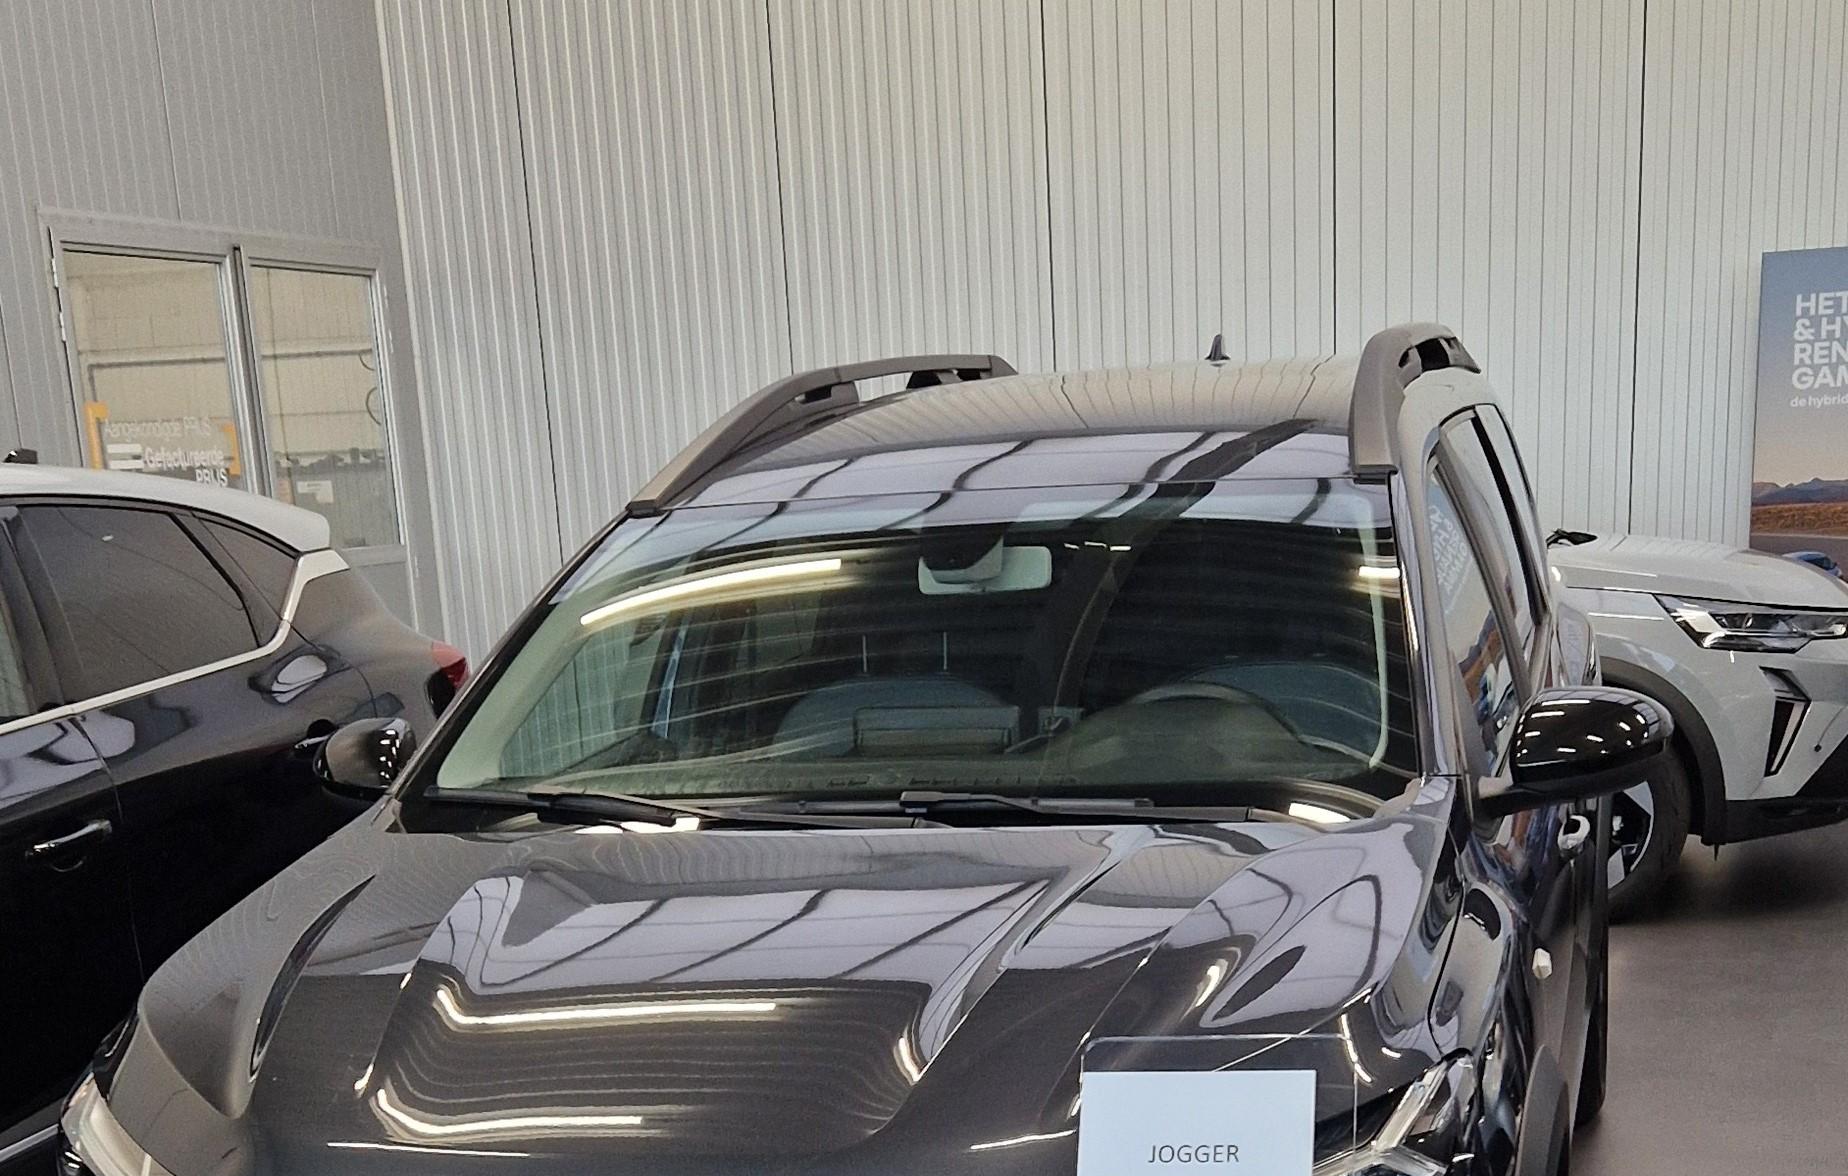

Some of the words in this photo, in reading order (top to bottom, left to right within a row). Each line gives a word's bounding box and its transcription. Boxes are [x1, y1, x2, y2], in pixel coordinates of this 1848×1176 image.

[1796, 291, 1848, 317] HET
[1793, 318, 1815, 341] &
[1821, 315, 1848, 340] H
[1790, 396, 1807, 407] de
[1148, 1144, 1239, 1163] JOGGER
